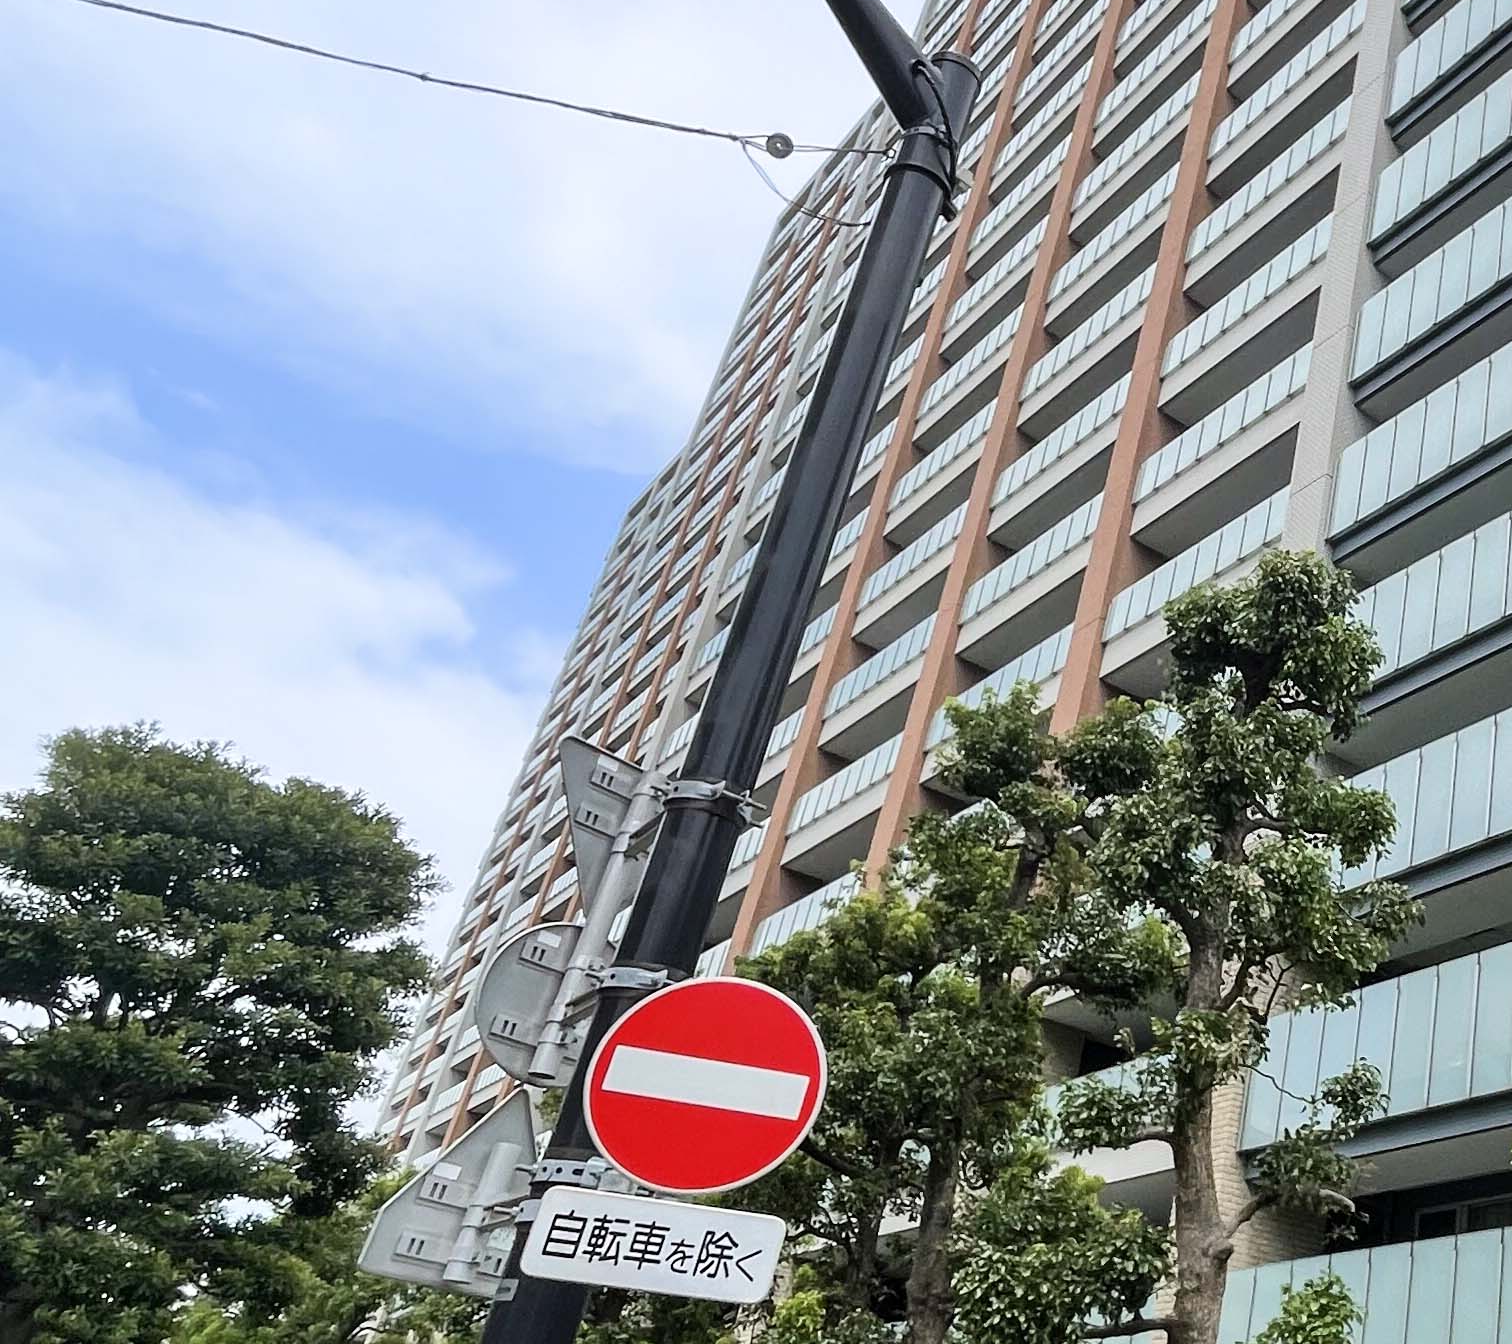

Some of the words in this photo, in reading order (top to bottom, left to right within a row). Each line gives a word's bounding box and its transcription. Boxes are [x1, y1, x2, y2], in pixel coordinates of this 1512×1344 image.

[541, 1209, 763, 1282] 自転車を除く
